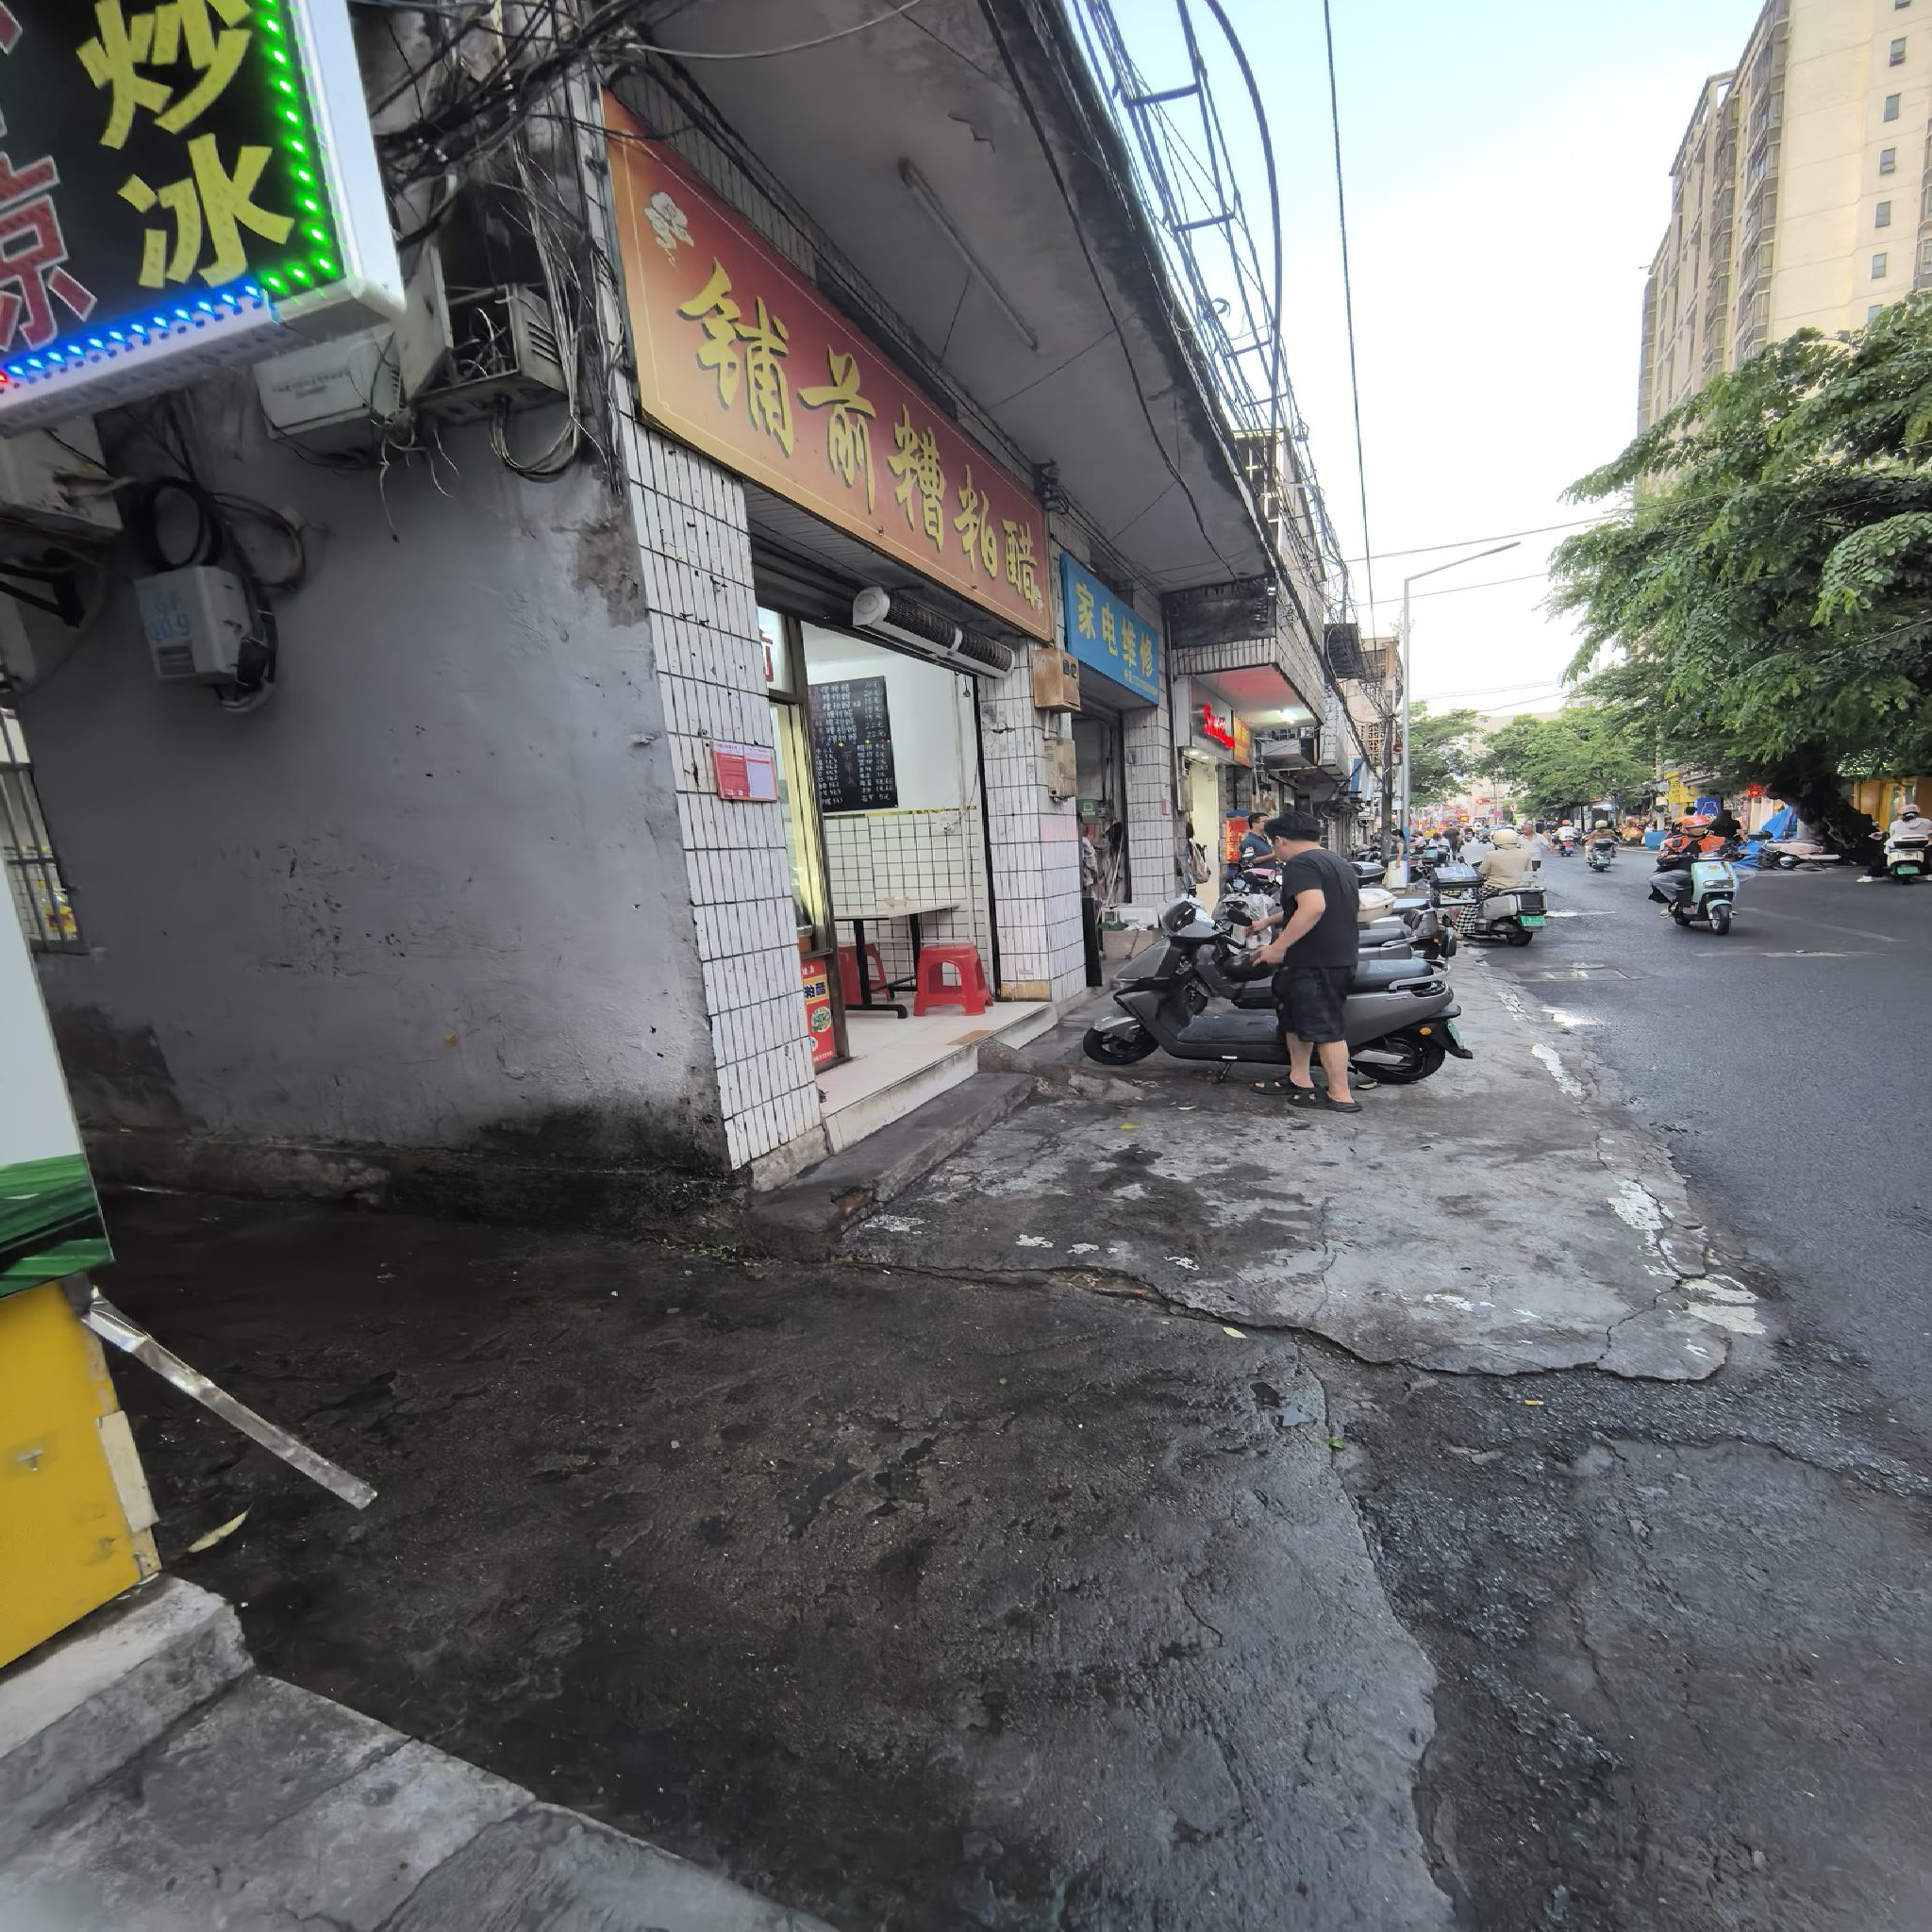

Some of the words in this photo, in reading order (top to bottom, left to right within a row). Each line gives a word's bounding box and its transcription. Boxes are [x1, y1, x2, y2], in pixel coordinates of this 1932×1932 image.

[76, 0, 294, 289] 炒冰
[1074, 582, 1153, 678] 家电维修
